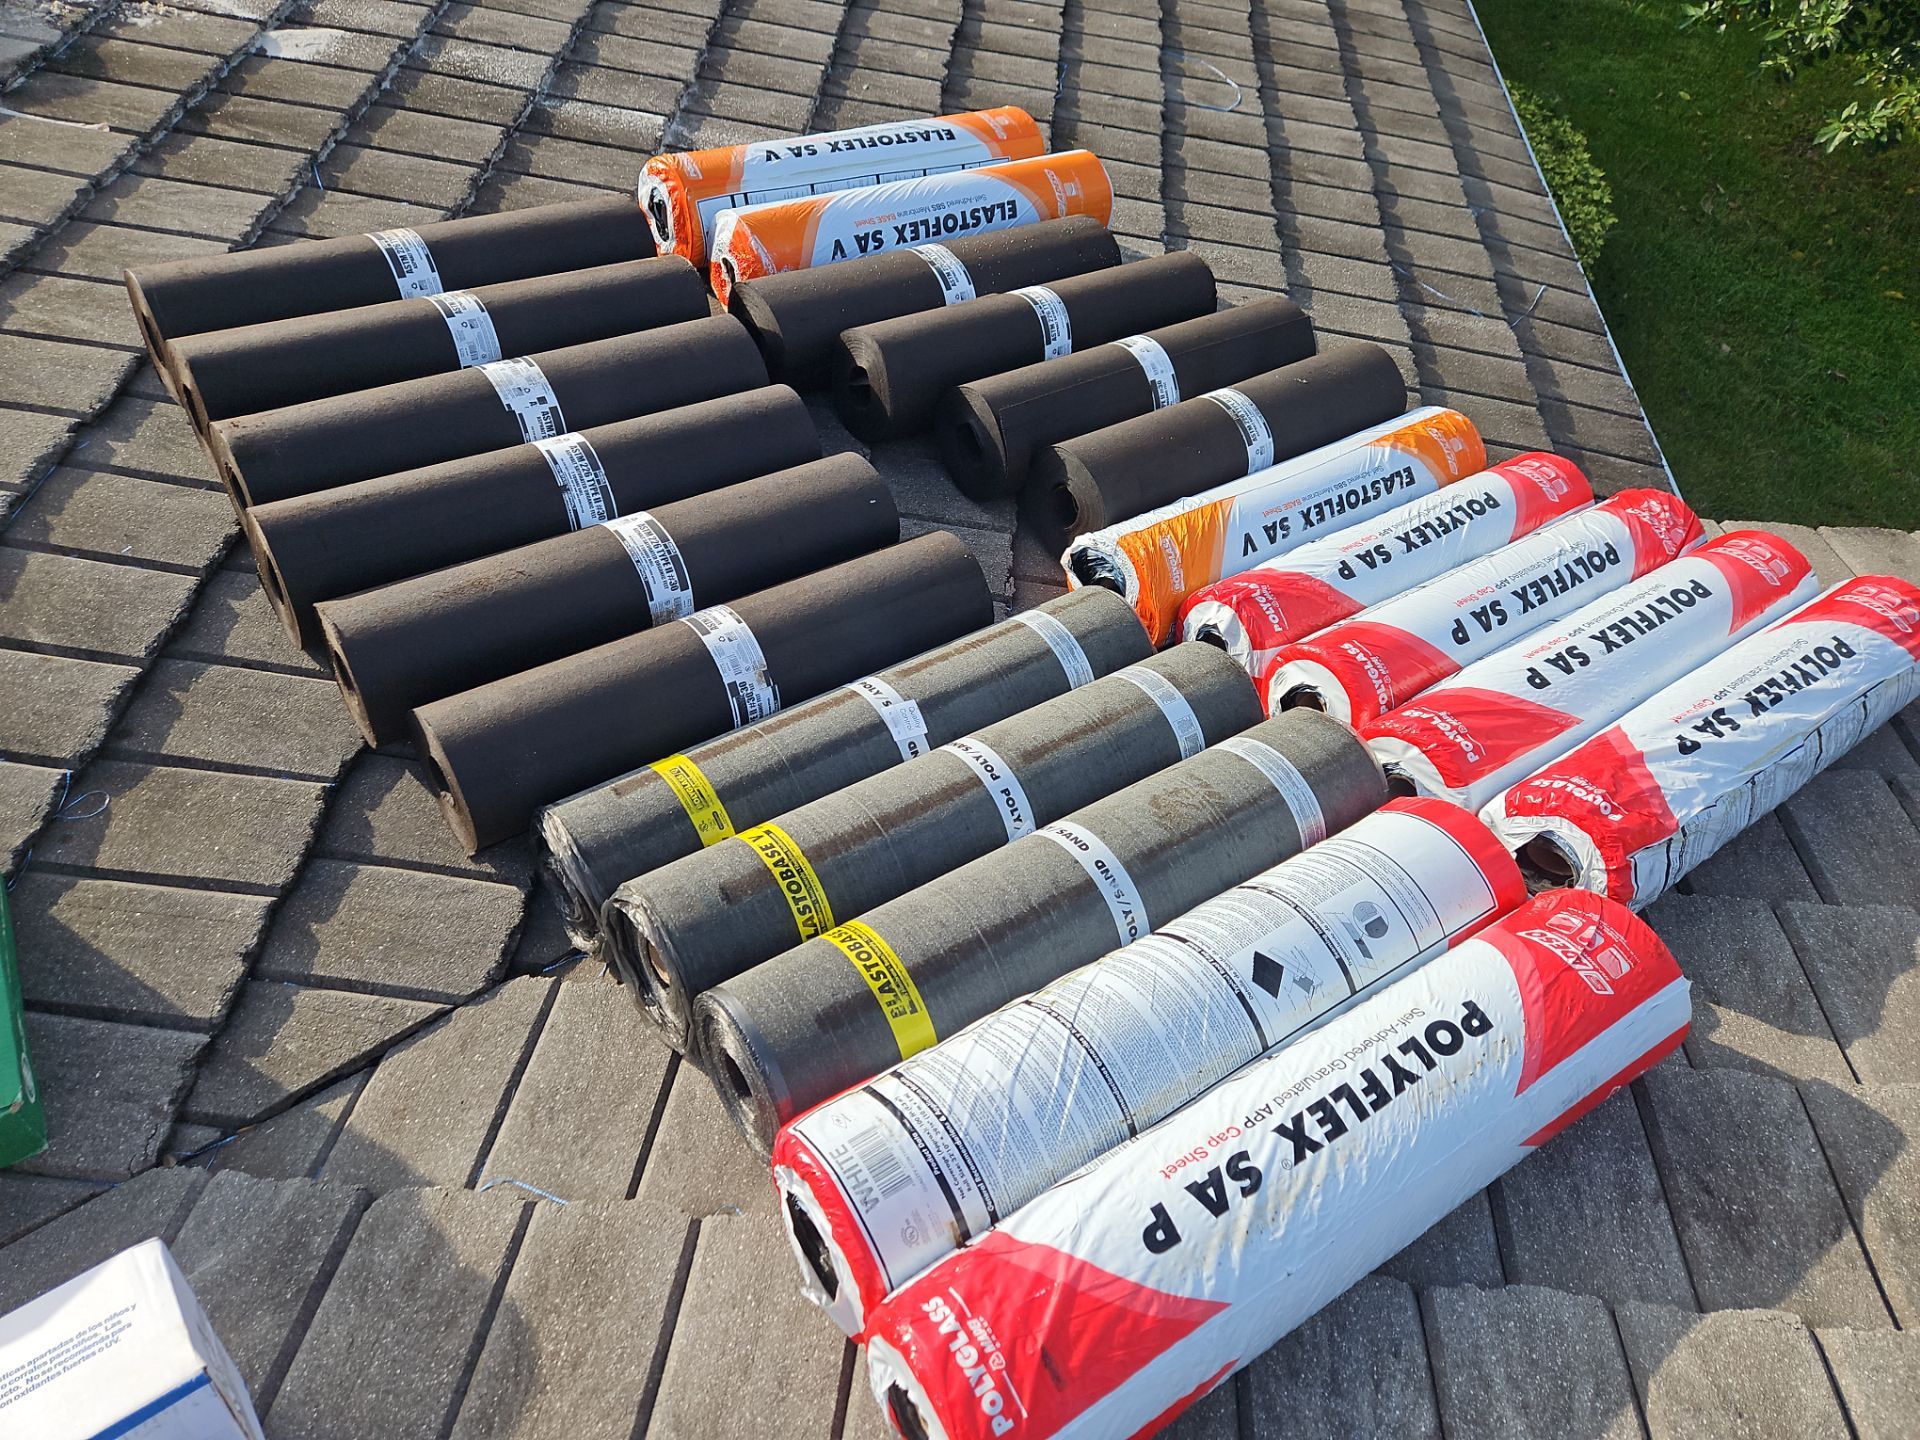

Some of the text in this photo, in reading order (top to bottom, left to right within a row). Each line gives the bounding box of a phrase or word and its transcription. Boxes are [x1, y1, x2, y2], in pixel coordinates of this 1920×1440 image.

[765, 149, 781, 162] V
[787, 144, 816, 157] SA
[827, 129, 955, 152] ELASTOFLEX
[875, 213, 896, 223] BASE
[896, 206, 930, 217] Membrane
[930, 202, 945, 211] SBS
[831, 200, 1016, 260] ELASTOFLEX SA V
[399, 255, 415, 274] ASTM
[541, 410, 556, 433] ASTM
[568, 445, 586, 463] ASTM
[579, 462, 593, 478] 226
[586, 476, 601, 498] TYPE
[1333, 480, 1347, 490] SBS
[1281, 498, 1301, 510] BASE
[1300, 467, 1414, 529] ELASTOFLEX
[1301, 486, 1333, 501] Membrane
[1261, 505, 1282, 517] Sheet
[1396, 492, 1499, 551] POLYFLEX
[1242, 532, 1257, 556] V
[1262, 516, 1290, 544] SA
[656, 545, 672, 567] TYPE
[667, 573, 680, 592] #30
[1338, 559, 1356, 580] P
[1355, 544, 1391, 569] SA
[1451, 543, 1619, 644] POLYFLEX SA P
[1477, 586, 1494, 595] Cap
[1494, 577, 1510, 589] APP
[1526, 580, 1710, 689] POLYFLEX SA P
[857, 681, 893, 708] POLY/S
[1342, 642, 1390, 715] POLYGLASS
[1676, 637, 1854, 755] POLYFLEX SA P
[1529, 778, 1624, 822] POLYGLASS
[747, 834, 764, 843] V
[759, 842, 820, 940] LASTOBASE
[829, 929, 908, 1019] ELASTOBAS
[1160, 1007, 1424, 1179] Self-Adhered Granulated APP Cap Sheet
[910, 1131, 941, 1175] Product Data
[942, 1120, 982, 1183] Recommendations
[830, 1145, 881, 1213] WHITE
[939, 1154, 960, 1186] Coverage
[961, 1178, 973, 1192] Roll
[1186, 1151, 1261, 1216] SA
[955, 1186, 967, 1199] Net
[976, 1181, 995, 1212] General
[1142, 1203, 1180, 1253] P
[8, 1360, 47, 1385] corrales
[48, 1347, 70, 1364] para
[71, 1332, 100, 1349] niños.
[104, 1319, 121, 1331] Las
[27, 1337, 73, 1366] apartadas
[75, 1330, 87, 1339] de
[87, 1321, 102, 1332] los
[103, 1307, 129, 1323] niños
[13, 1370, 61, 1400] oxidantes
[62, 1350, 96, 1372] fuertes
[104, 1336, 120, 1348] UV.
[25, 1373, 40, 1384] No
[40, 1366, 52, 1376] se
[54, 1334, 109, 1368] recomienda
[111, 1322, 131, 1337] para
[920, 1295, 1015, 1437] POLYGLASS
